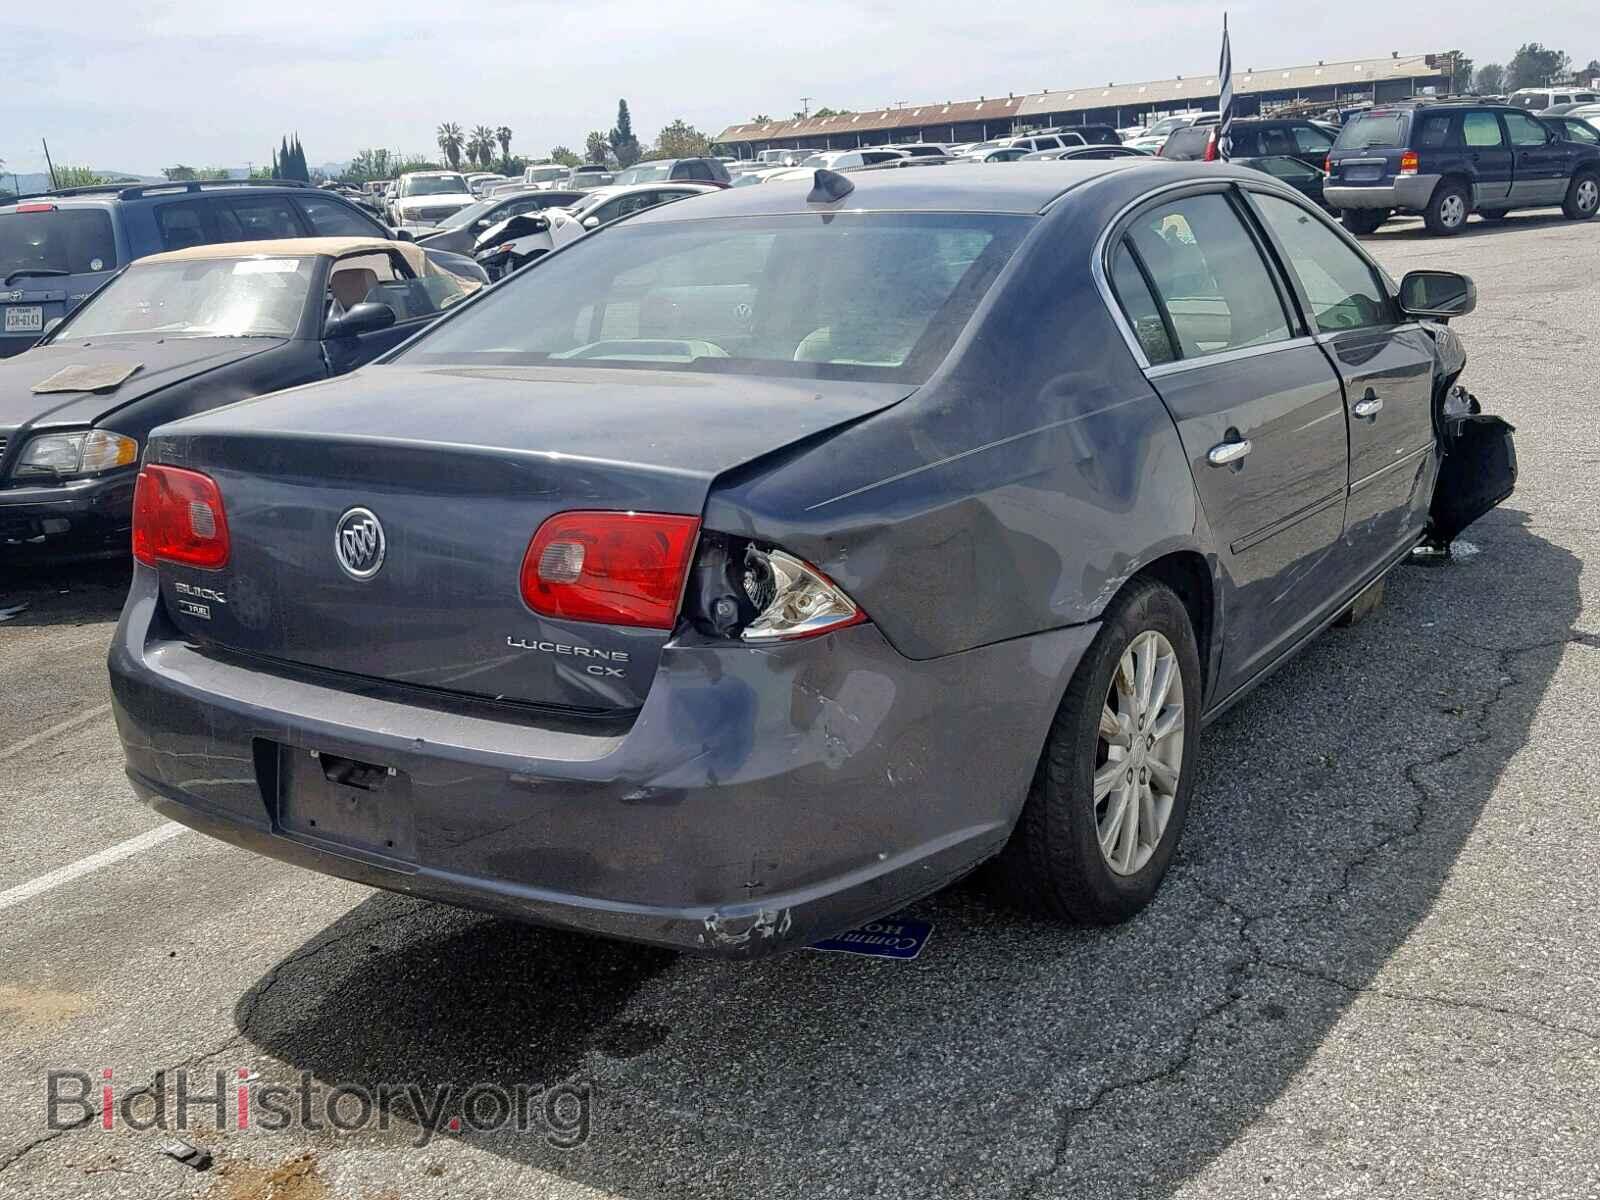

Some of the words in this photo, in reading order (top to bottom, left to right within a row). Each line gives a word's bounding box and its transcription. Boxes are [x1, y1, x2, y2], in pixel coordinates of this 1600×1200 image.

[175, 582, 226, 603] BUICK
[506, 636, 629, 662] LUCERNE
[586, 665, 625, 678] CX
